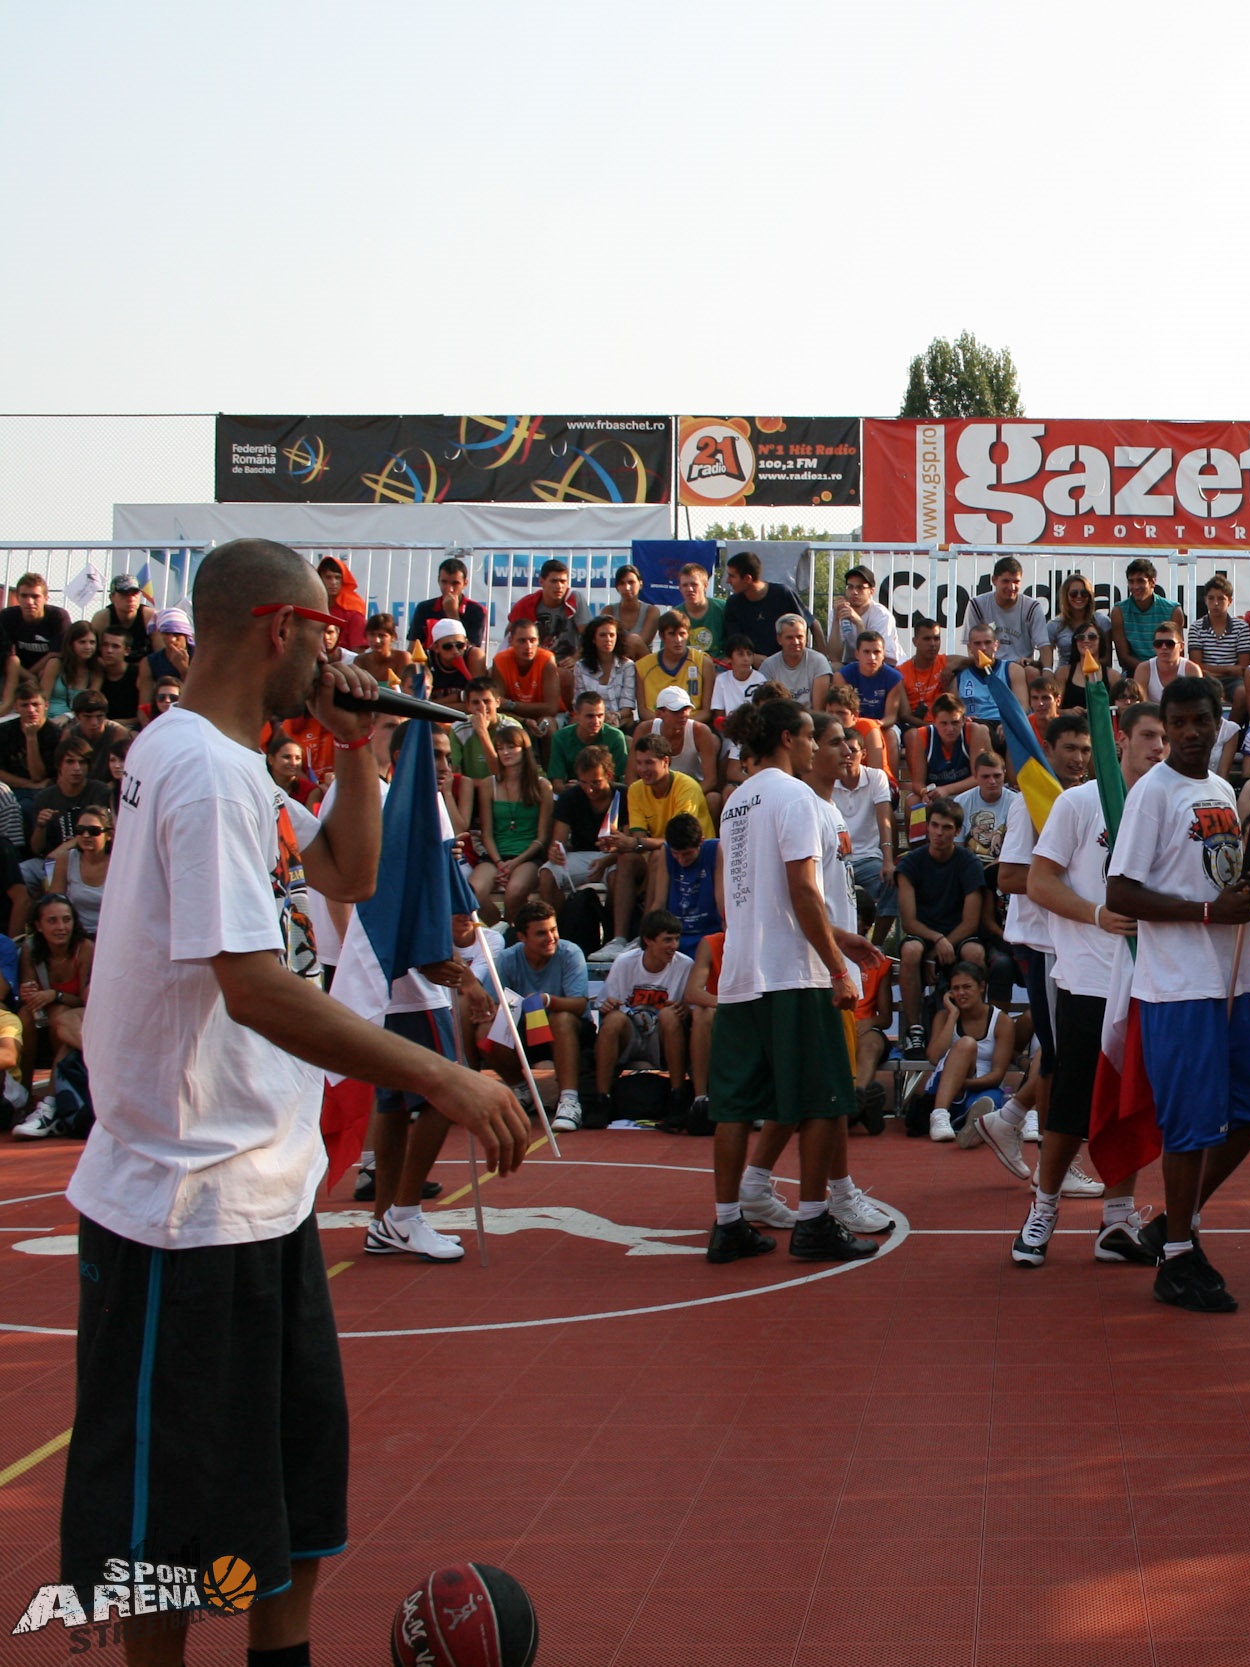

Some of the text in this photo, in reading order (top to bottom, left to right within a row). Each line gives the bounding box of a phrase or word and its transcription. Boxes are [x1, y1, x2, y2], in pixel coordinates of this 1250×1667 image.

[566, 420, 665, 430] www.frbaschet.ro
[789, 444, 808, 456] Hit
[815, 443, 857, 456] Radio
[231, 466, 276, 474] de Baschet
[690, 461, 727, 479] radio
[758, 458, 818, 471] 100,2 FM
[758, 473, 843, 481] www.radio21.ro
[922, 427, 941, 540] www.gsp.ro
